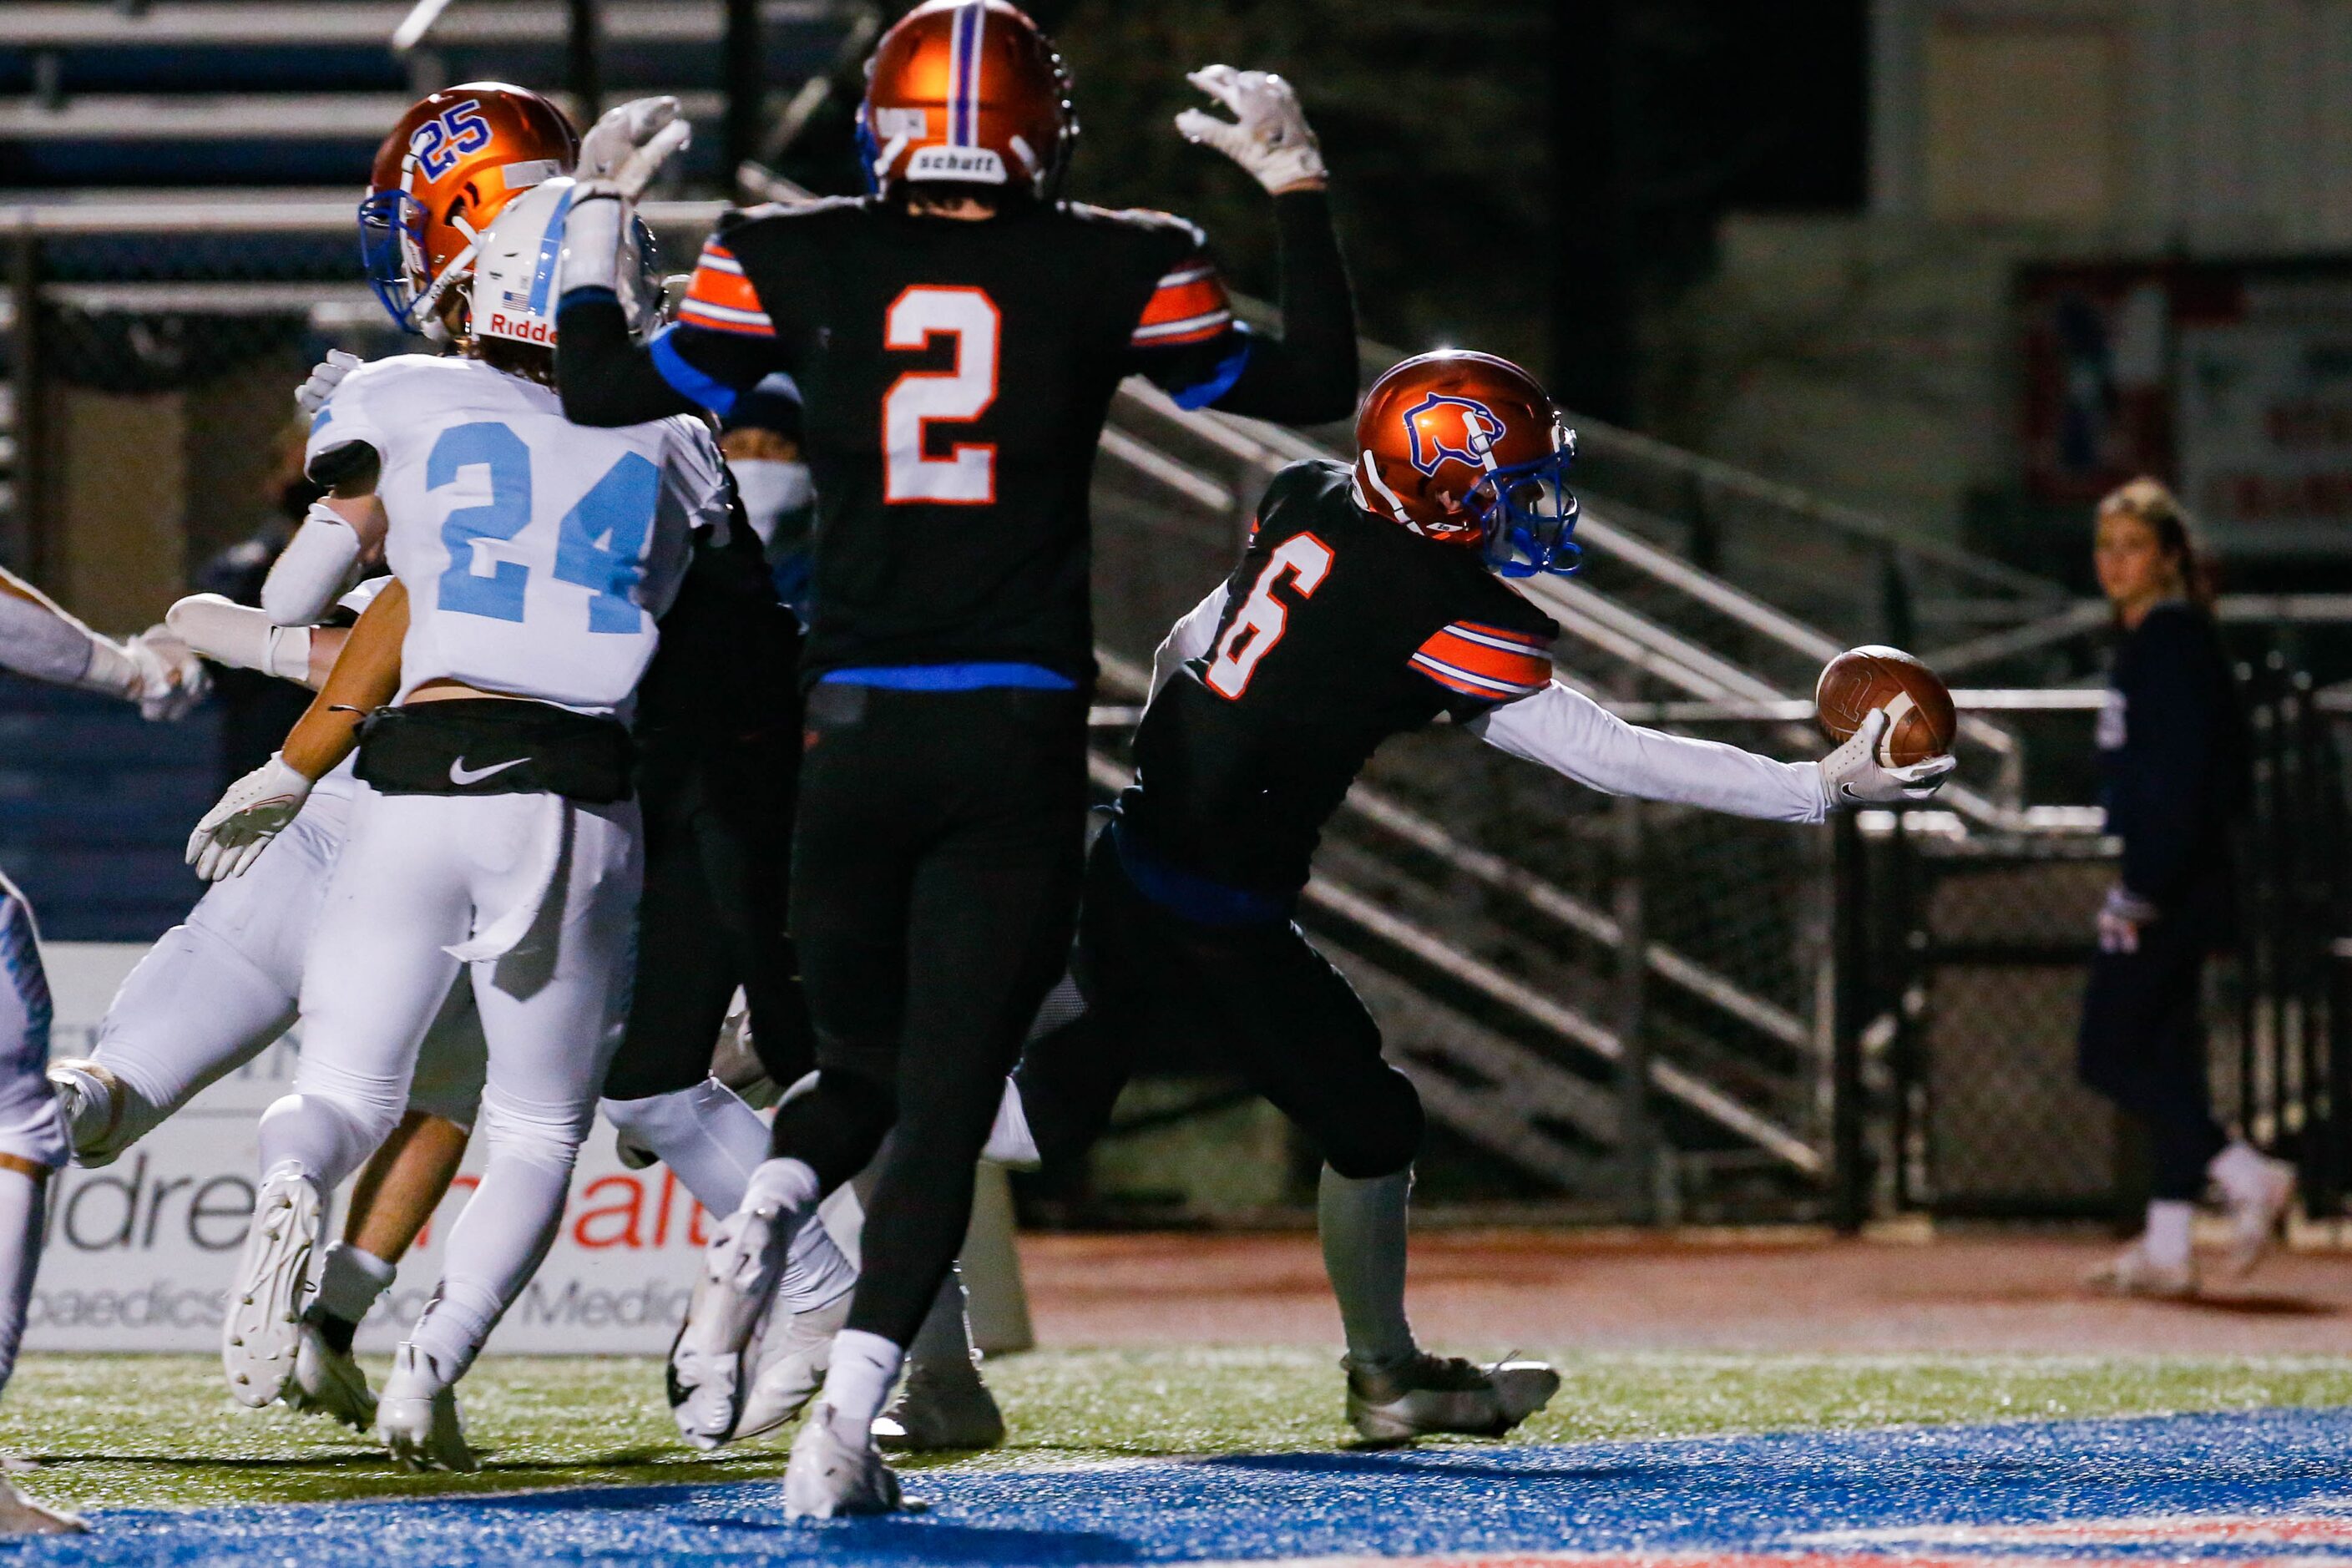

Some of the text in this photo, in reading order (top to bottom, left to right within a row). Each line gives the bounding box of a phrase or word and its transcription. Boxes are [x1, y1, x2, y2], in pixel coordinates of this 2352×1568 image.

[409, 99, 493, 184] 25
[919, 154, 994, 171] schutt
[882, 284, 1001, 505] 2
[427, 421, 659, 635] 24
[1205, 530, 1335, 701] 6
